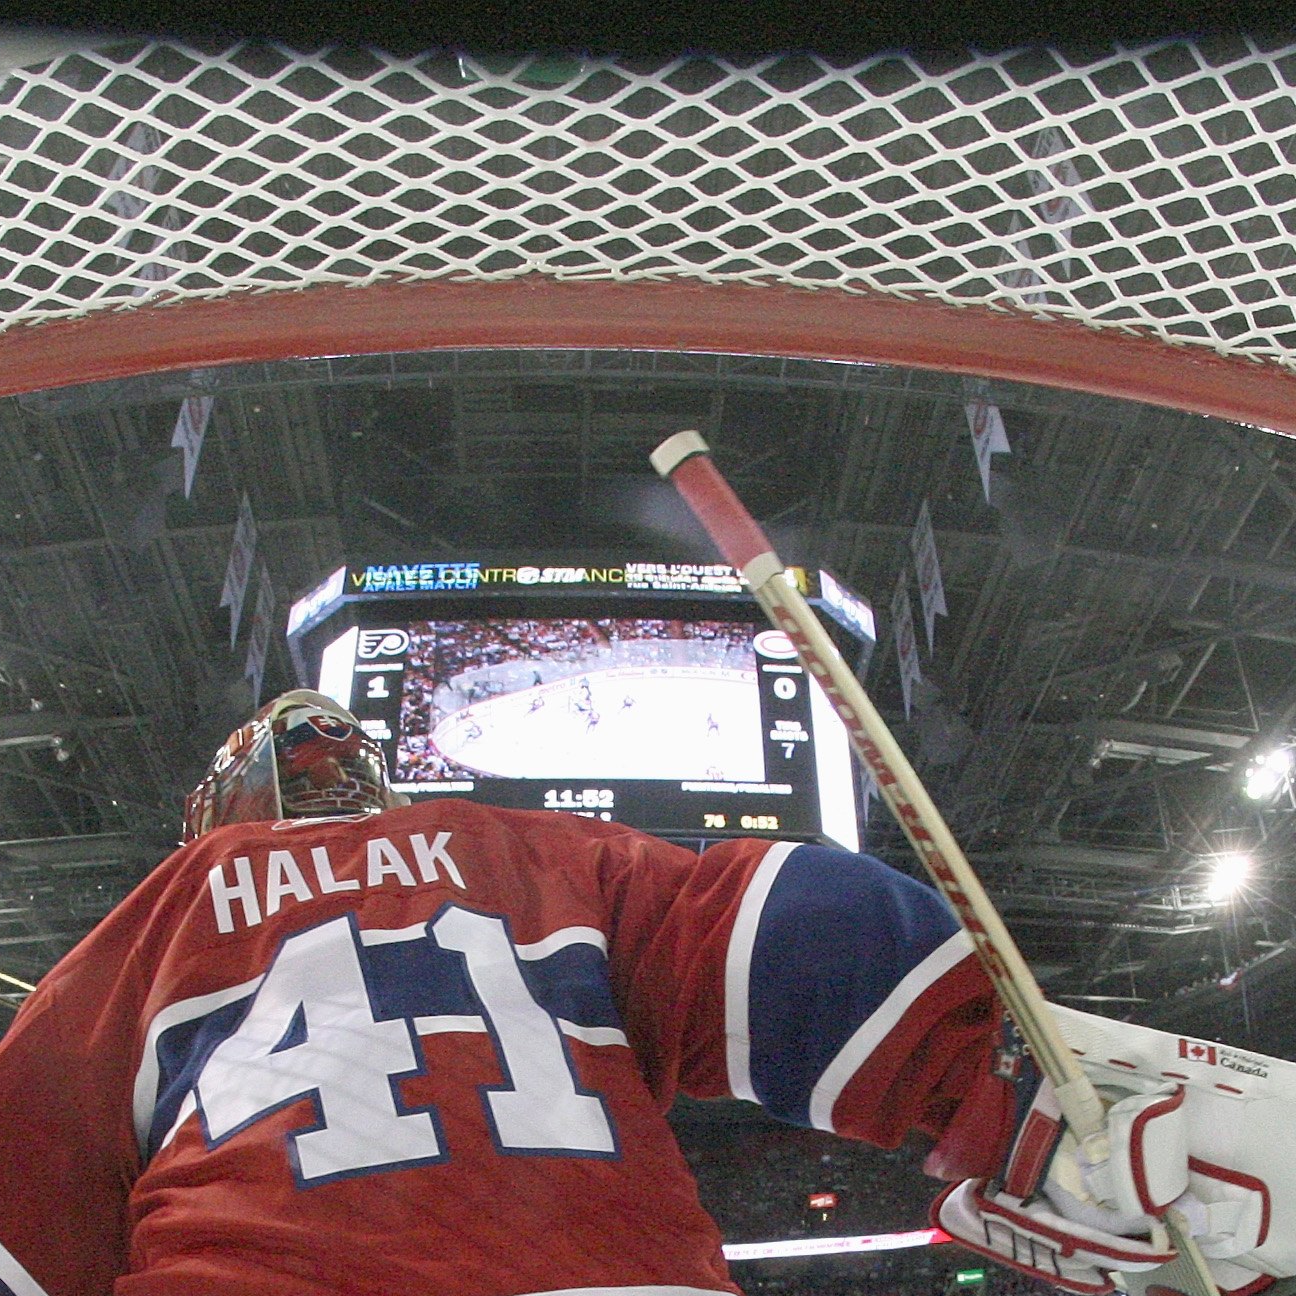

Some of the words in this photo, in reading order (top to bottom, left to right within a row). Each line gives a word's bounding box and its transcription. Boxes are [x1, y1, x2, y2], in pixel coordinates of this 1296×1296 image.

[626, 563, 666, 575] VERS
[670, 564, 733, 576] L'OUEST
[367, 676, 390, 699] 1
[773, 677, 797, 700] 0
[781, 742, 795, 759] 7
[544, 789, 615, 808] 11:52
[740, 815, 779, 830] 0:52
[208, 831, 466, 934] HALAK
[193, 901, 621, 1191] 41
[1220, 1057, 1268, 1079] Canada
